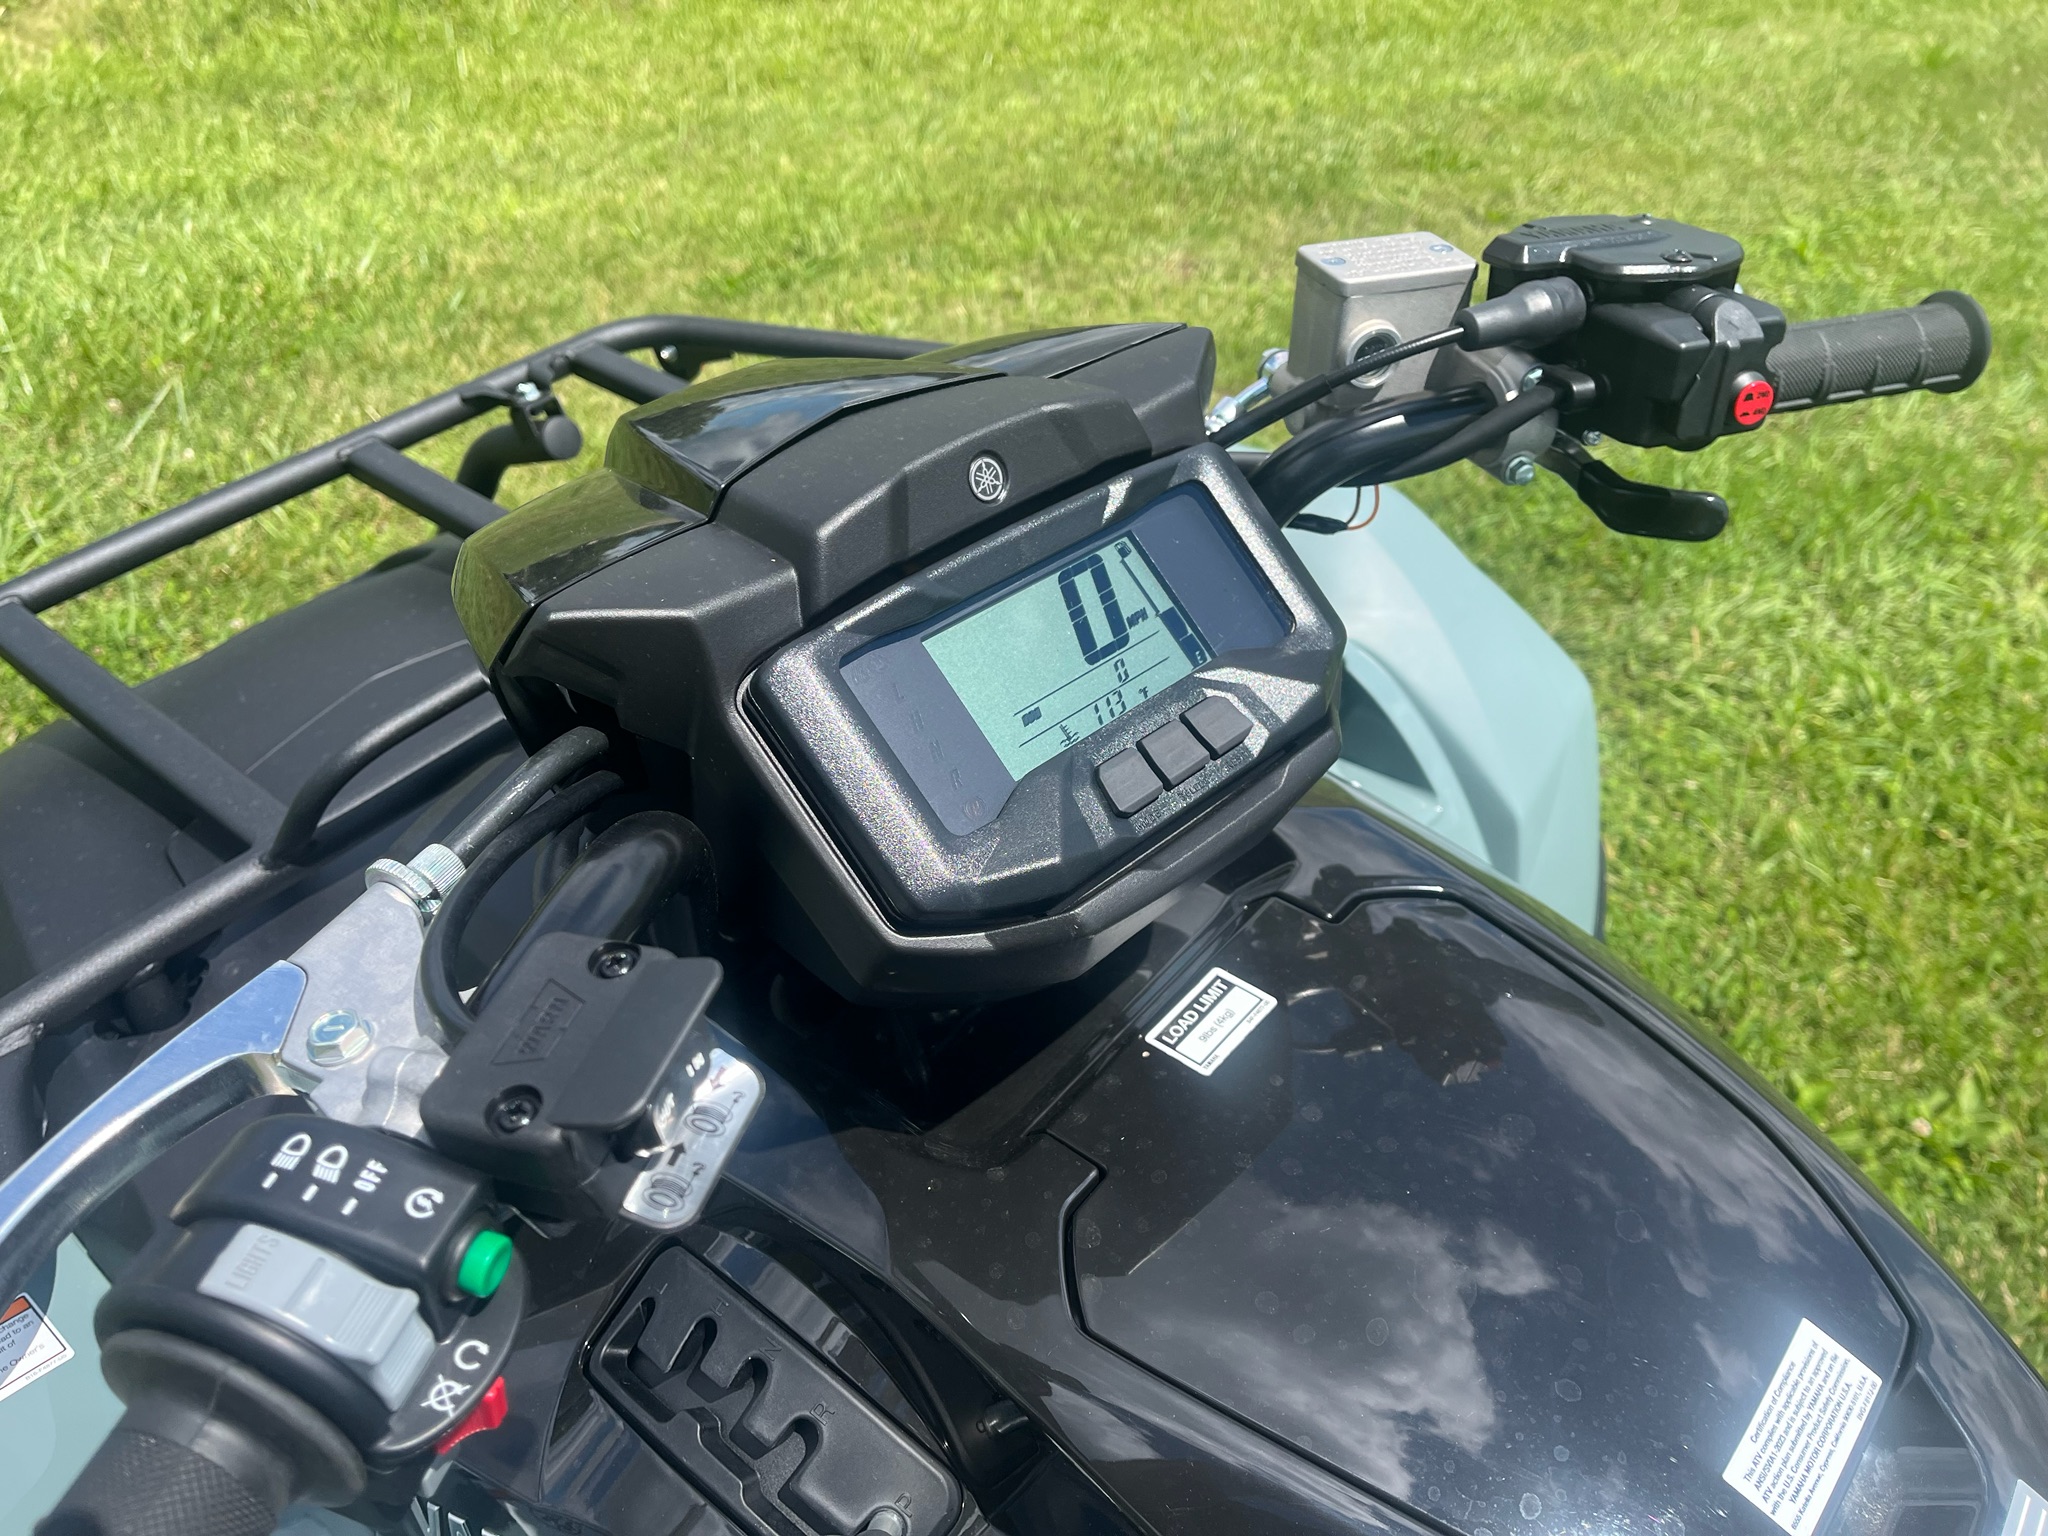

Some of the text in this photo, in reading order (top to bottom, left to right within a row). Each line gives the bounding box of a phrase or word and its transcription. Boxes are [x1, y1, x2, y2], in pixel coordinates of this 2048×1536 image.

[1058, 554, 1130, 665] 0
[1126, 607, 1149, 630] MPH
[1114, 658, 1129, 683] 0
[1094, 690, 1127, 725] 113
[1162, 979, 1229, 1045] LOAD LIMIT
[1199, 1025, 1217, 1042] 9lbs
[1215, 1008, 1236, 1029] (4kg)
[353, 1158, 388, 1193] OFF
[225, 1233, 281, 1292] LIGHTS
[7, 1339, 16, 1348] of
[758, 1336, 783, 1362] N
[1810, 1347, 1829, 1378] approved
[1827, 1362, 1835, 1372] on
[1803, 1384, 1810, 1393] to
[1808, 1376, 1815, 1386] an
[1820, 1370, 1830, 1384] and
[1750, 1359, 1797, 1443] Certification of Compliance
[1791, 1391, 1808, 1417] subject
[1807, 1382, 1825, 1412] YAMAHA
[809, 1401, 836, 1427] R
[1744, 1465, 1755, 1483] This
[1751, 1451, 1763, 1468] ATV
[1759, 1422, 1779, 1455] complies
[1773, 1408, 1785, 1425] with
[1780, 1376, 1802, 1411] applicable
[1796, 1347, 1817, 1380] provisions
[1788, 1414, 1796, 1423] is
[1803, 1409, 1813, 1421] by
[1782, 1420, 1792, 1436] and
[1787, 1418, 1808, 1452] submitted
[1769, 1498, 1781, 1516] with
[1777, 1486, 1787, 1500] the
[1783, 1471, 1795, 1489] U.S.
[1790, 1438, 1812, 1474] Consumer
[1806, 1413, 1824, 1441] Product
[1819, 1393, 1834, 1416] Safety
[1780, 1450, 1793, 1468] plan
[1789, 1472, 1809, 1504] YAMAHA
[1803, 1446, 1821, 1475] MOTOR
[1816, 1398, 1845, 1449] CORPORATION
[1769, 1465, 1784, 1489] action
[894, 1492, 912, 1518] P
[1762, 1486, 1773, 1503] ATV
